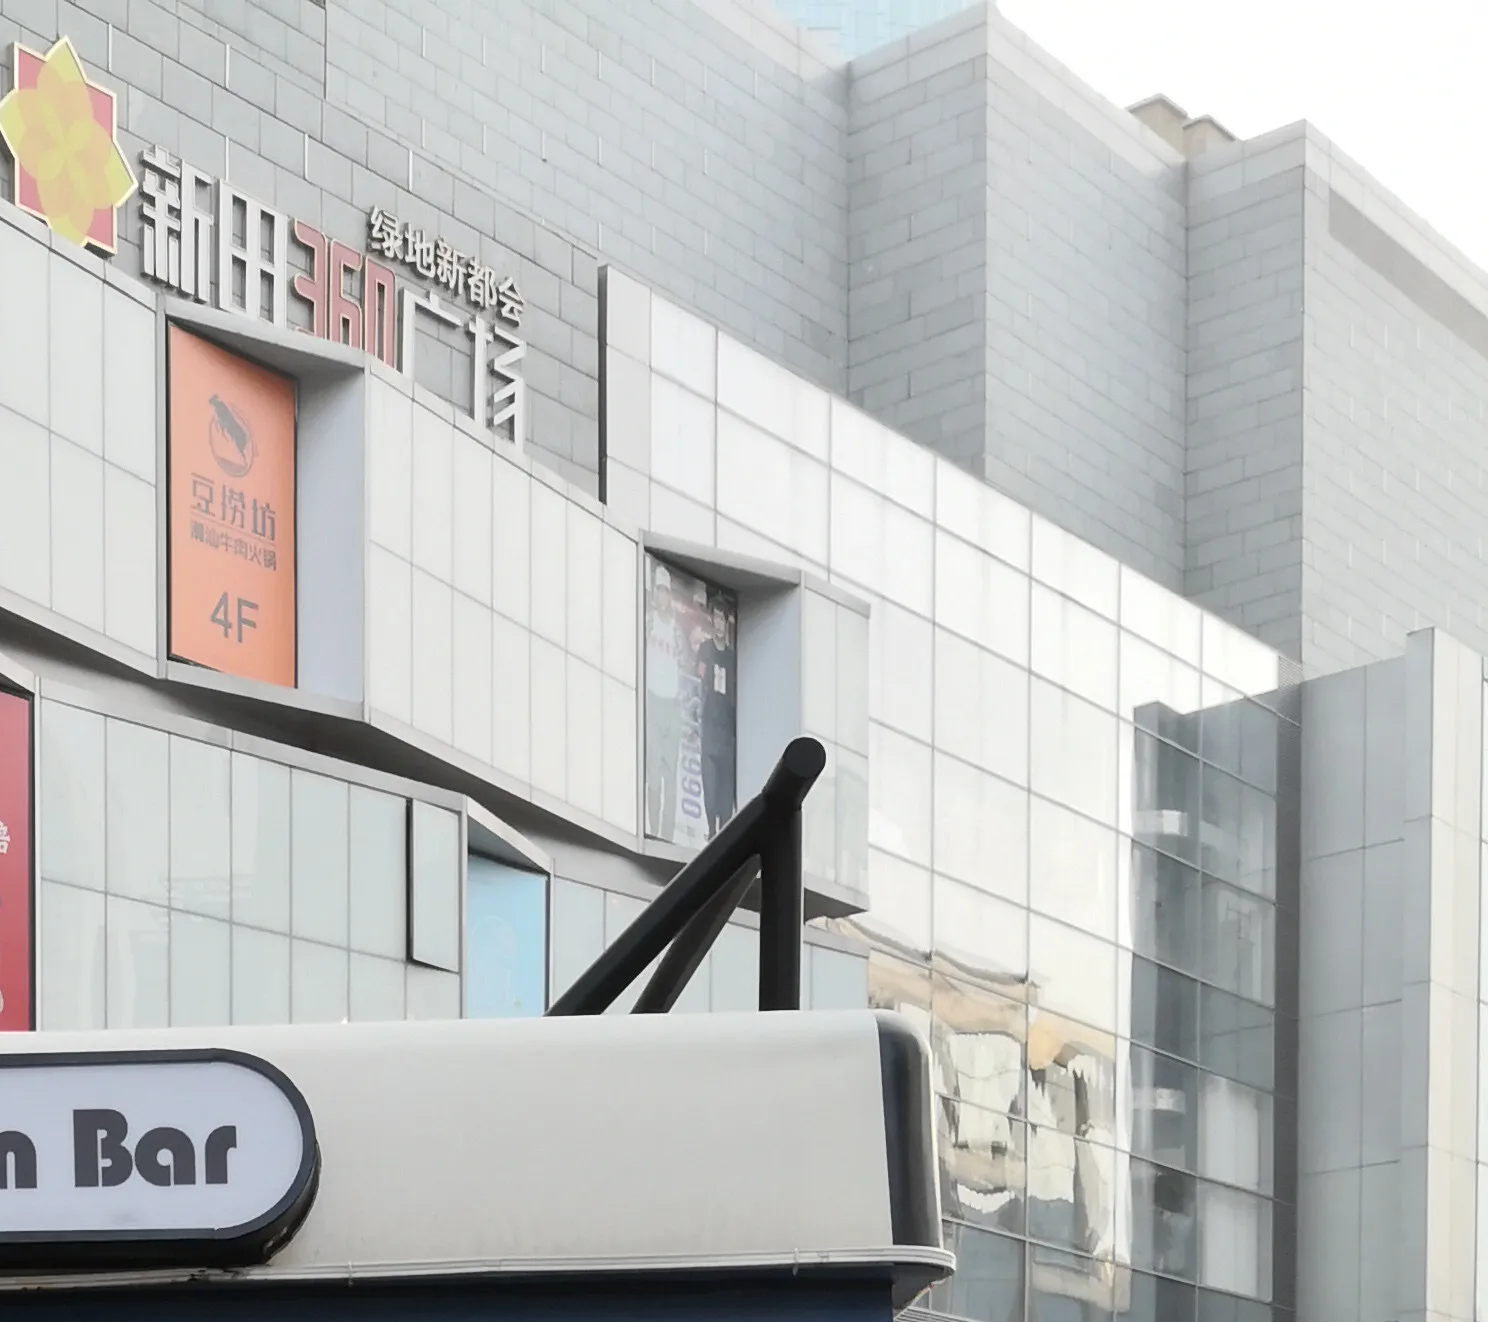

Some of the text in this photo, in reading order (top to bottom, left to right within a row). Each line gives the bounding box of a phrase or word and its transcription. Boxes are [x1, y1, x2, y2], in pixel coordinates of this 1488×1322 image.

[369, 205, 526, 327] 绿地新都会
[190, 473, 276, 541] 豆捞坊
[210, 592, 259, 643] 4F
[74, 1109, 237, 1187] Bar
